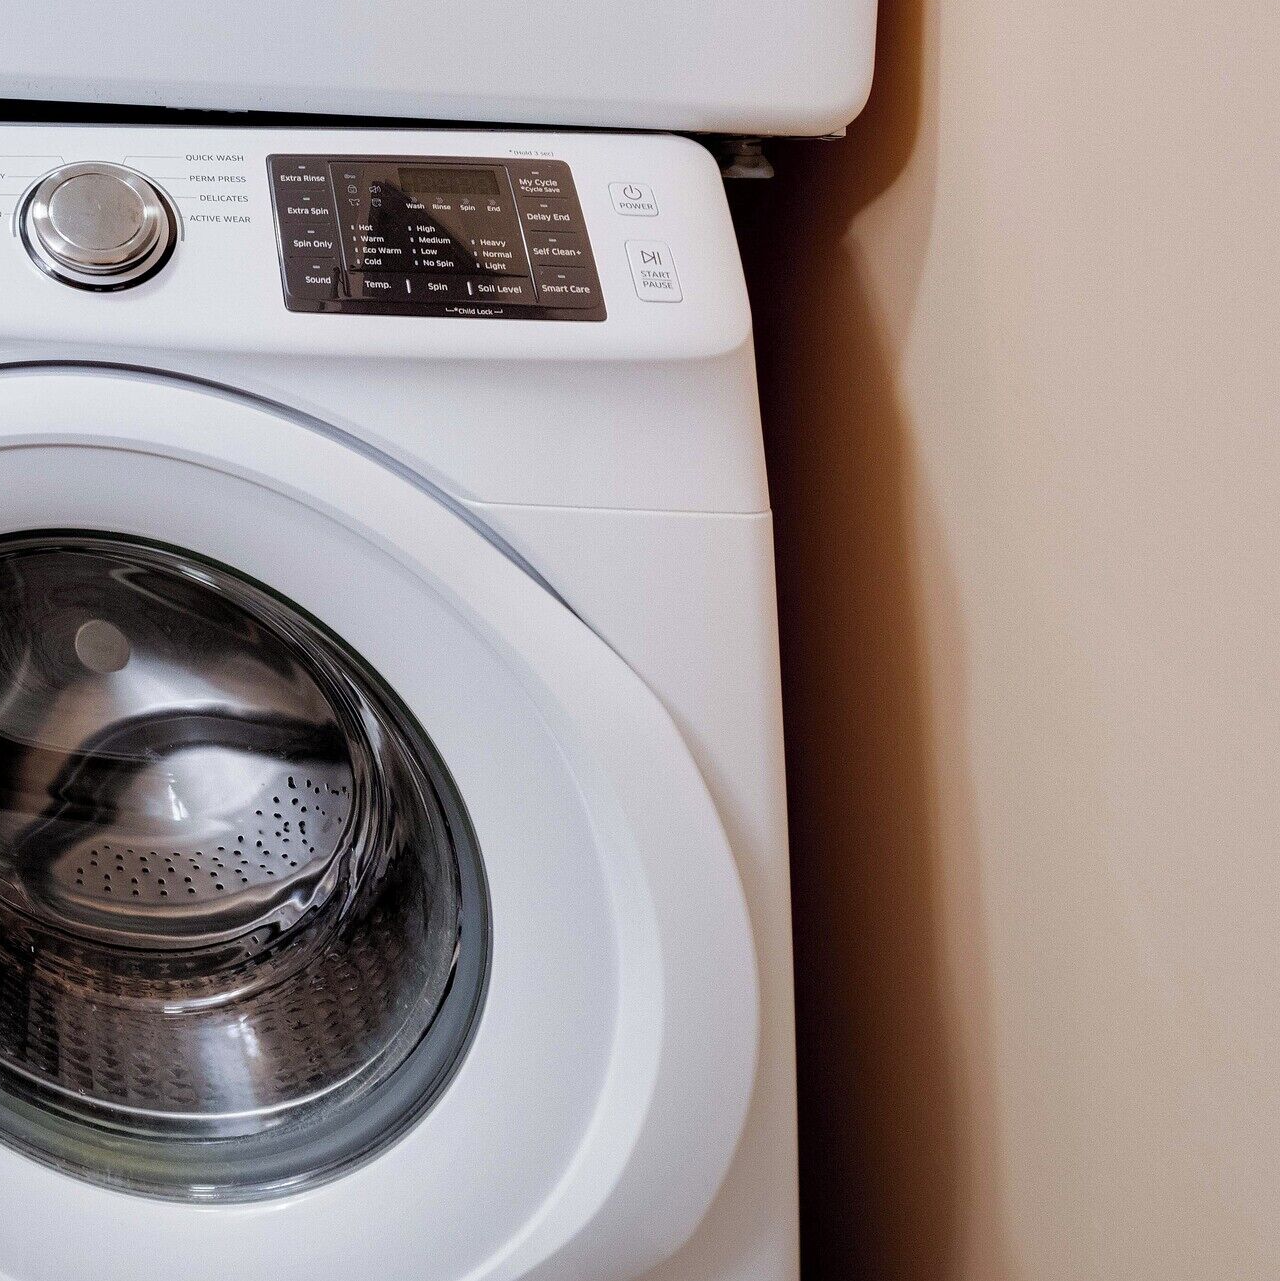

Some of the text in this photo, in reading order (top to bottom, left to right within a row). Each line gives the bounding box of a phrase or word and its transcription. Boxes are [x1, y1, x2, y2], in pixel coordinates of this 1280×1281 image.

[185, 153, 245, 162] QUICK WASH
[189, 174, 247, 183] PERM PRESS
[280, 174, 326, 183] Extra Rinse
[518, 178, 558, 188] My Cycle
[199, 194, 249, 203] DELICATES
[405, 202, 426, 210] Wash
[432, 203, 452, 211] Rinse
[459, 204, 477, 212] Spin
[486, 205, 502, 213] End
[619, 201, 654, 211] POWER
[287, 207, 330, 216] Extra Spin
[189, 214, 252, 223] ACTIVE WEAR
[526, 213, 571, 223] Delay End
[358, 224, 374, 232] Hot
[416, 224, 437, 234] High
[293, 239, 333, 249] Spin Only
[360, 235, 385, 244] Warm
[418, 236, 452, 245] Medium
[479, 238, 507, 249] Heavy
[362, 247, 403, 256] Eco Warm
[420, 247, 438, 256] Low
[482, 250, 513, 260] Normal
[533, 247, 550, 256] Self
[364, 258, 383, 266] Cold
[422, 259, 455, 269] No Spin
[485, 262, 507, 271] Light
[640, 269, 671, 280] START
[305, 275, 332, 285] Sound
[364, 280, 393, 290] Temp.
[427, 282, 449, 293] Spin
[477, 284, 523, 295] Soil Level
[541, 284, 591, 295] Smart Care
[642, 280, 674, 290] PAUSE
